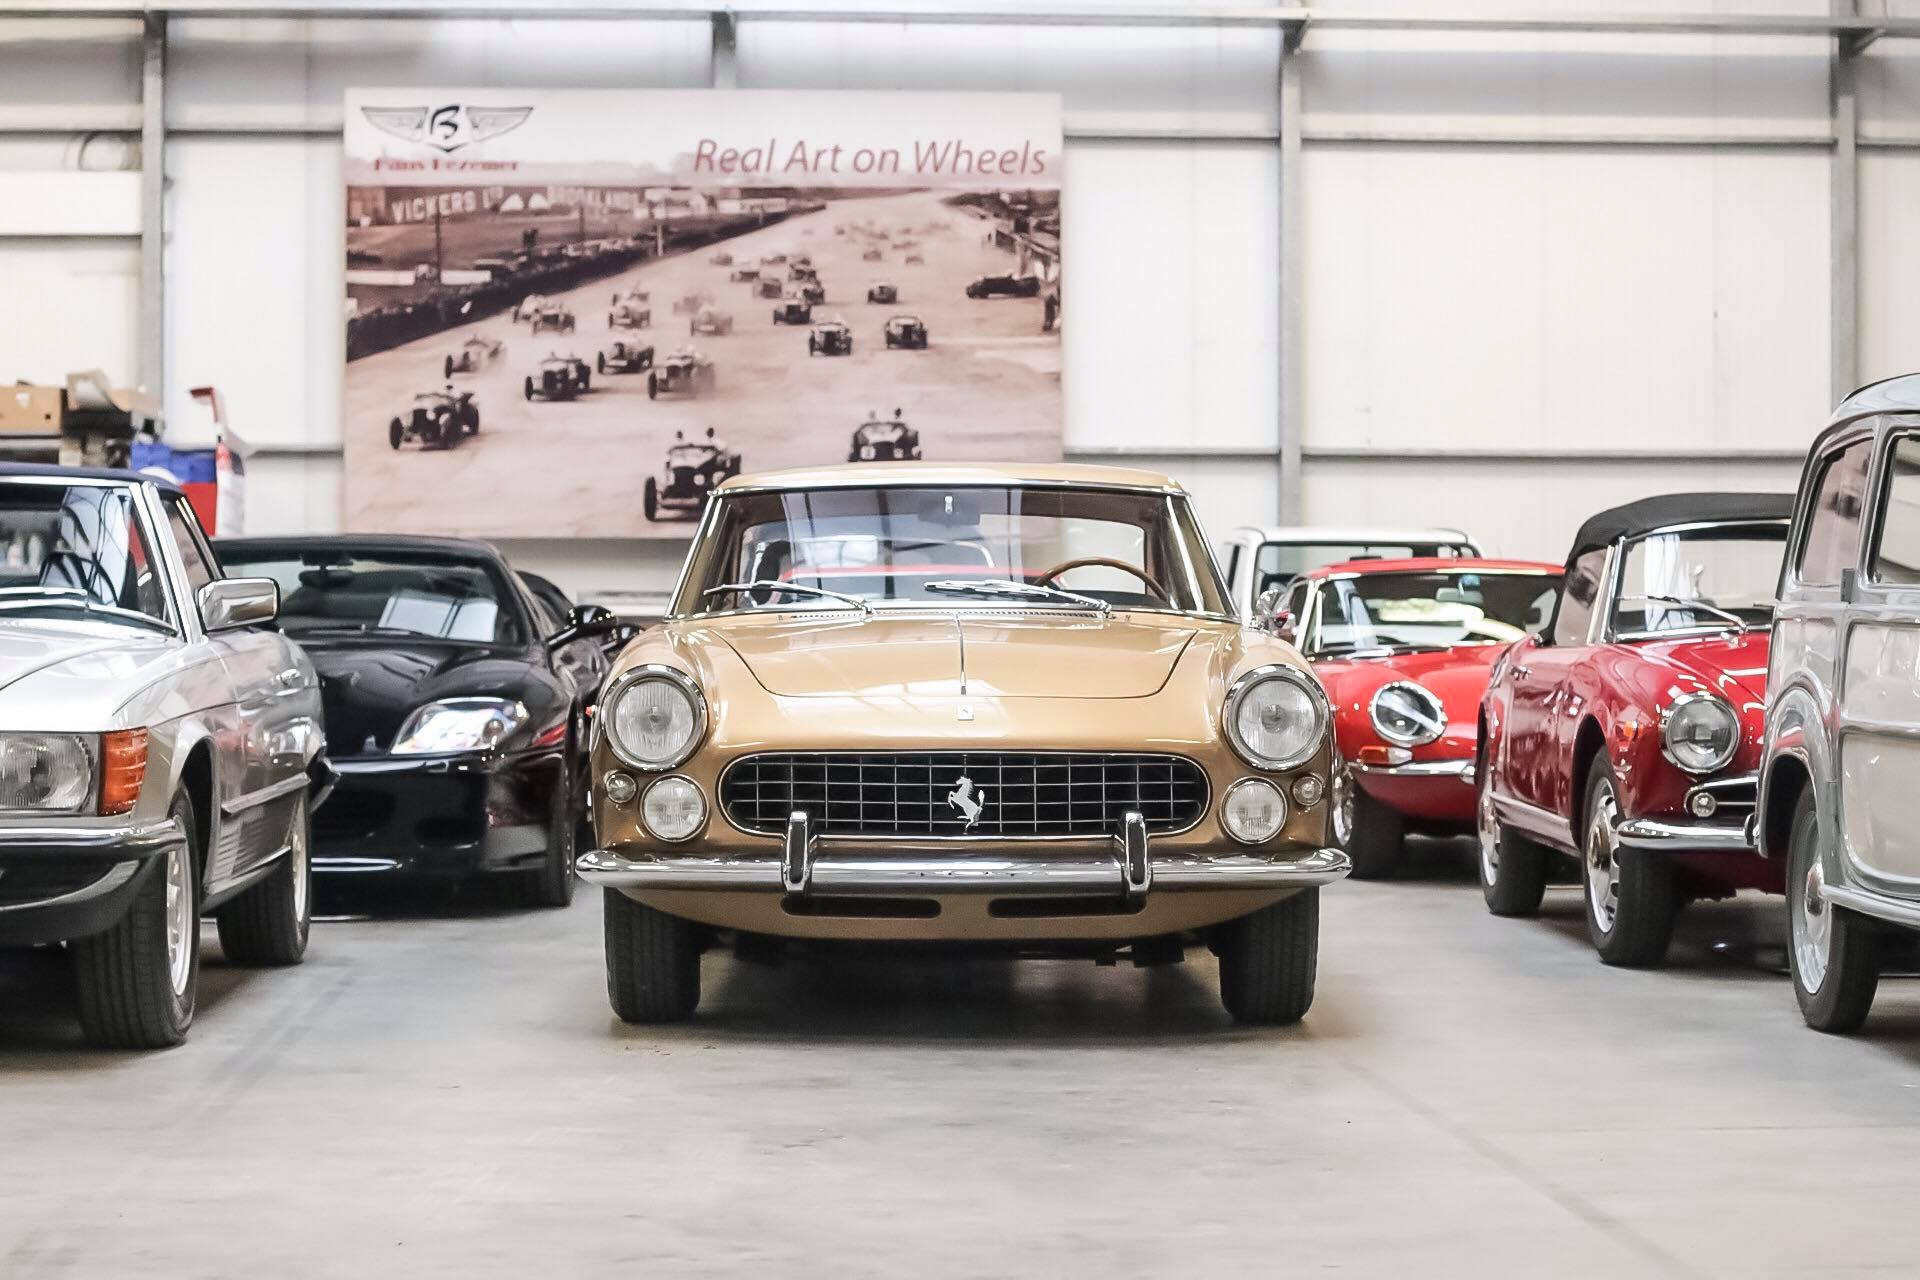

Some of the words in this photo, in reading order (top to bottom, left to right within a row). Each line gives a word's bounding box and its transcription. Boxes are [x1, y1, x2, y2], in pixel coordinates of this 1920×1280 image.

[694, 138, 776, 174] Real
[783, 139, 844, 174] Art
[852, 148, 900, 174] on
[914, 138, 1047, 176] Wheels
